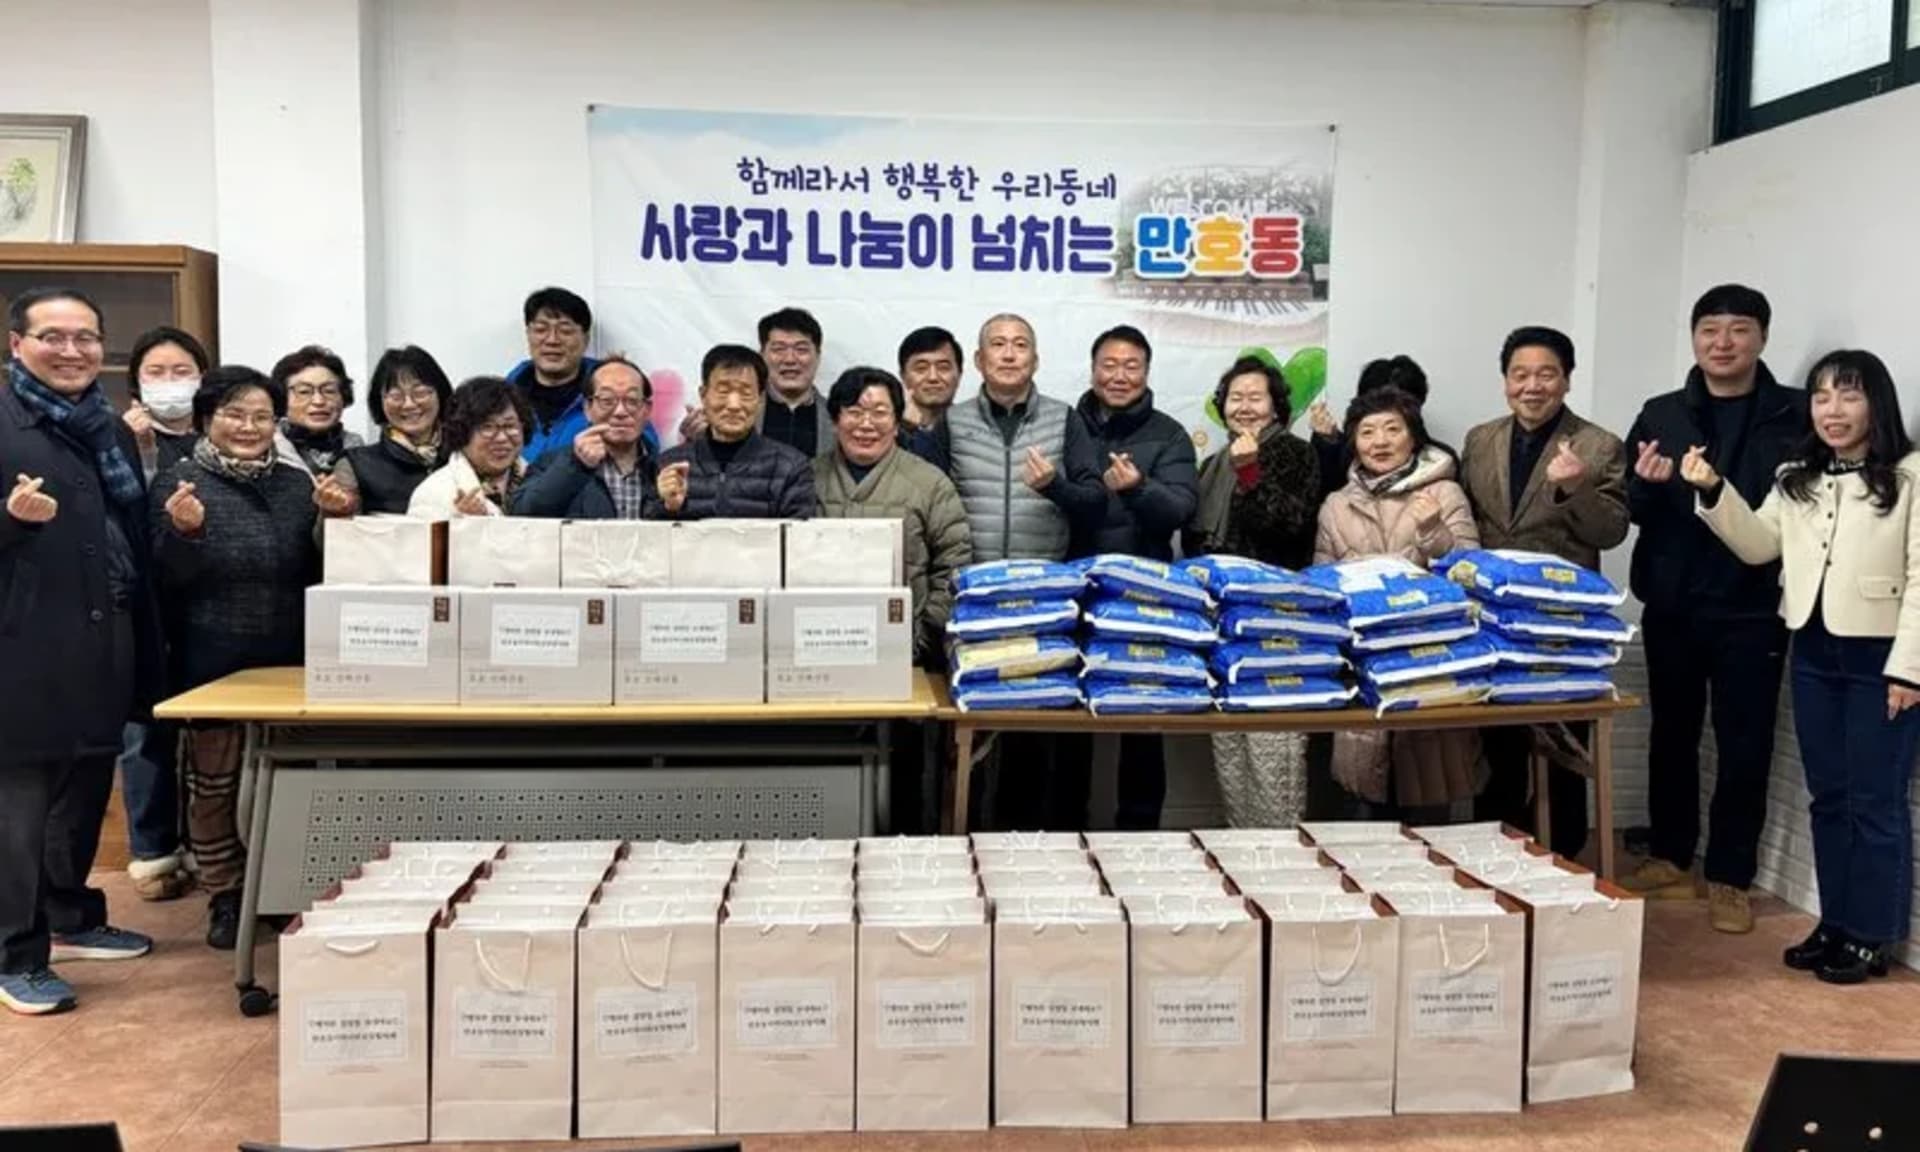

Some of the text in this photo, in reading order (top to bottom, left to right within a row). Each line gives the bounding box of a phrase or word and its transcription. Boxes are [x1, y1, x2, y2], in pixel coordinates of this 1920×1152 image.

[737, 157, 1116, 206] 함께라서 행복한 우리동네
[641, 203, 1302, 276] 사랑과 나눔이 넘치는 만호동
